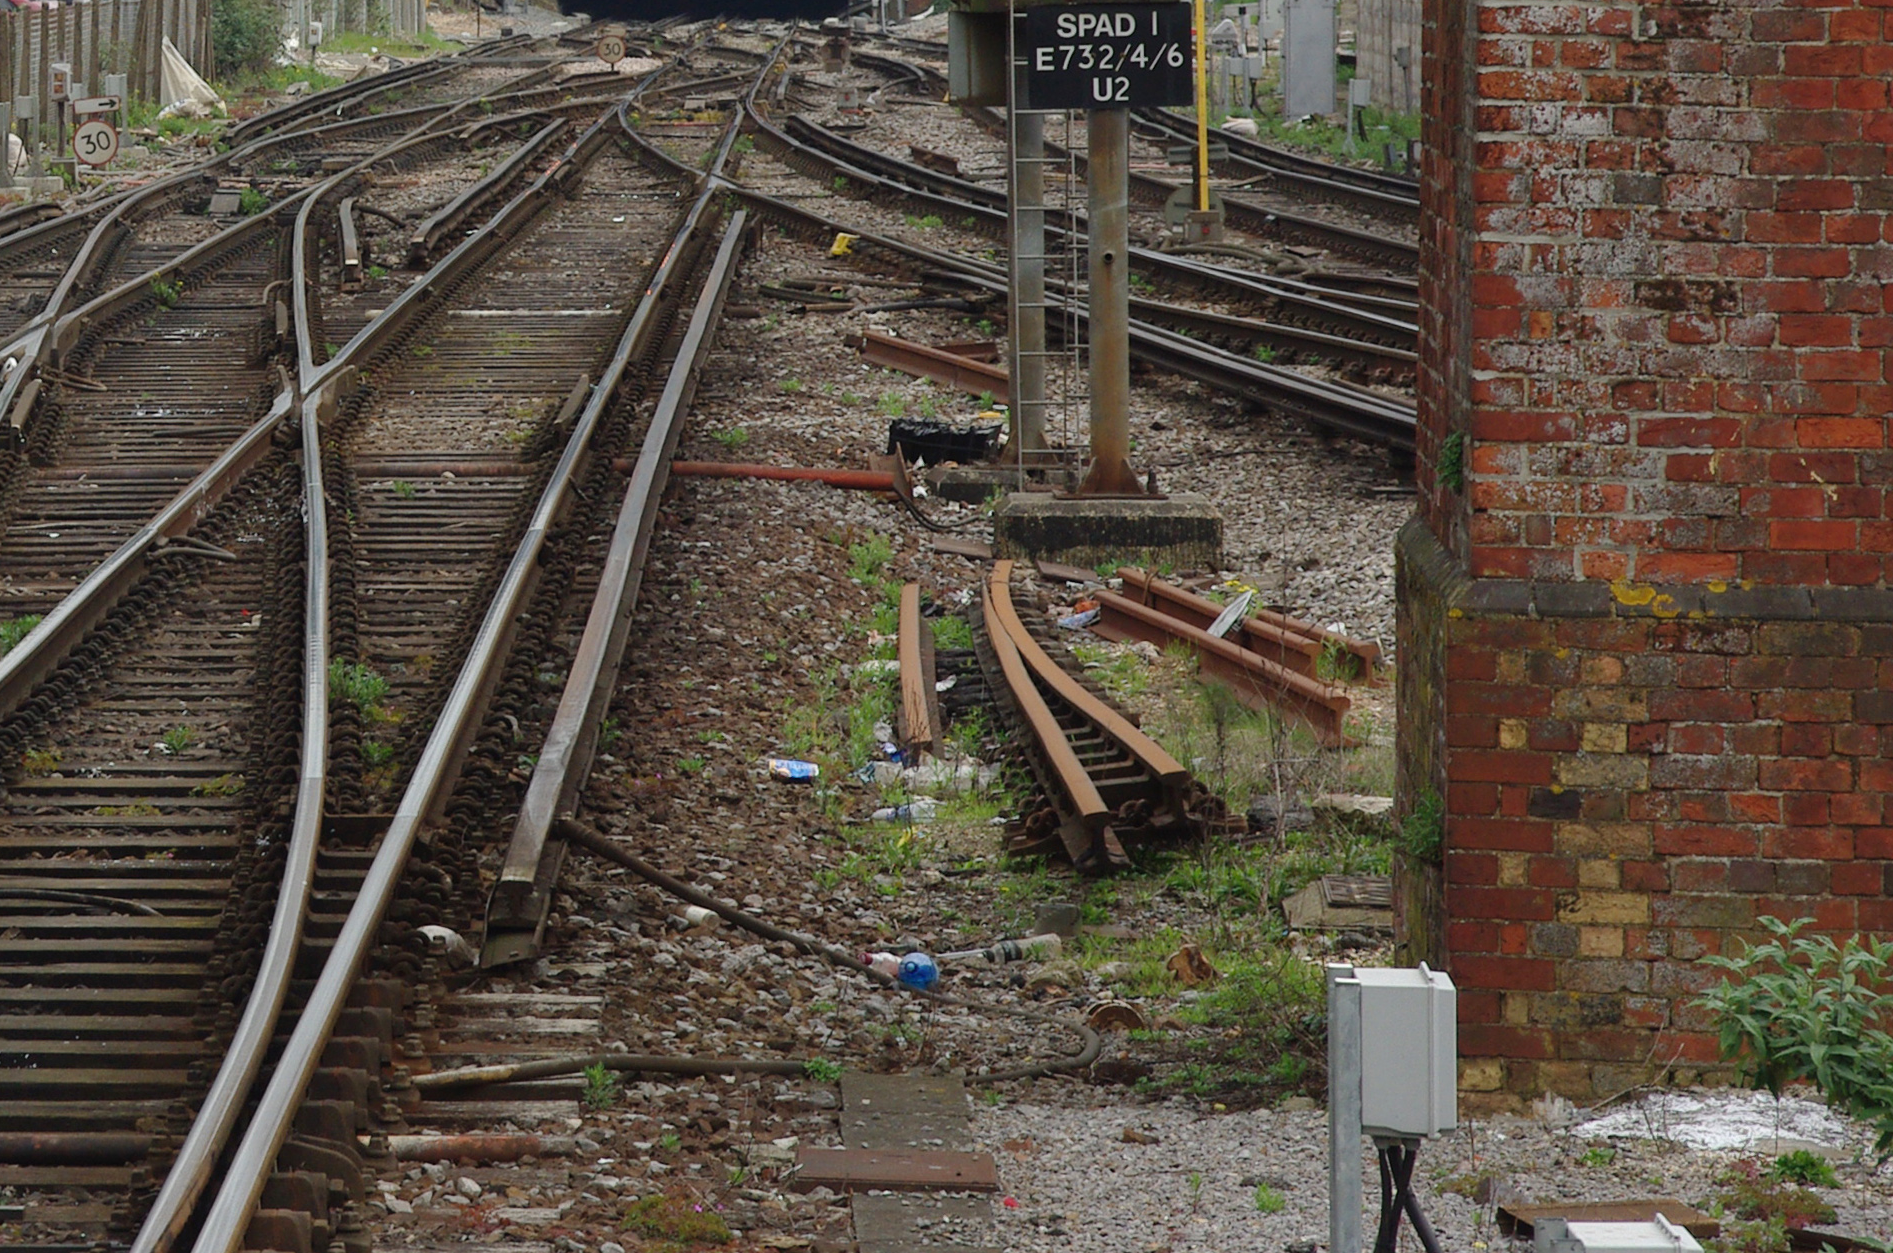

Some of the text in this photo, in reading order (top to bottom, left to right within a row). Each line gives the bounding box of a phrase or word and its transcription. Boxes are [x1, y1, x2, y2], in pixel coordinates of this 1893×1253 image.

[1057, 12, 1136, 39] SPAD
[603, 42, 621, 56] 30
[1036, 42, 1184, 72] E732/4/6
[1092, 76, 1130, 102] U2
[80, 130, 111, 155] 30
